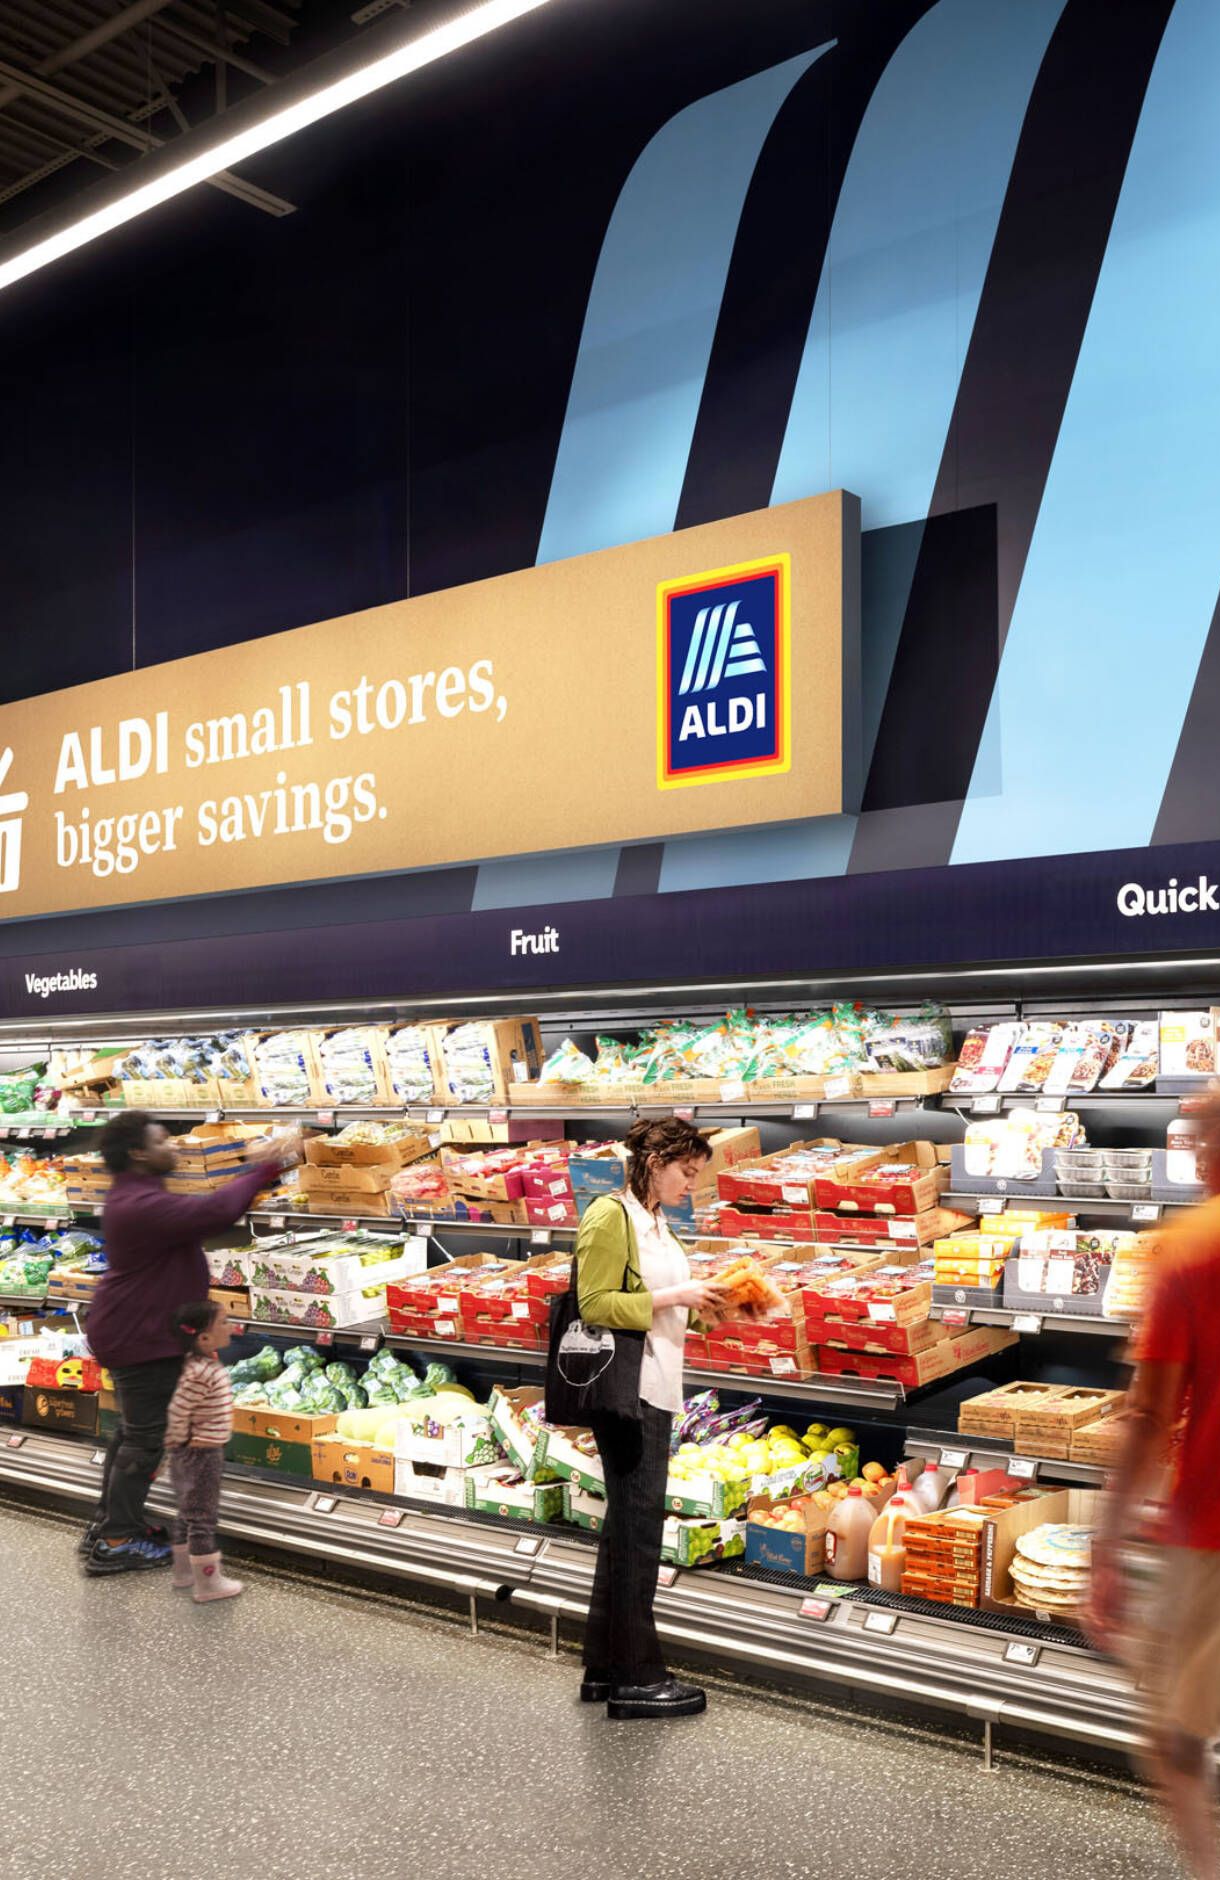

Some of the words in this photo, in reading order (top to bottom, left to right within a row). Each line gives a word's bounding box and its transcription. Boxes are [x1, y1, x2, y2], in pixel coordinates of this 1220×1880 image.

[53, 711, 169, 794] ALDI
[184, 681, 314, 768] small
[329, 659, 508, 740] stores,
[678, 692, 766, 742] ALDI
[53, 805, 184, 877] bigger
[197, 771, 388, 845] savings.
[1117, 875, 1220, 917] Quick
[511, 925, 560, 956] Fruit
[24, 967, 98, 999] Vegetables
